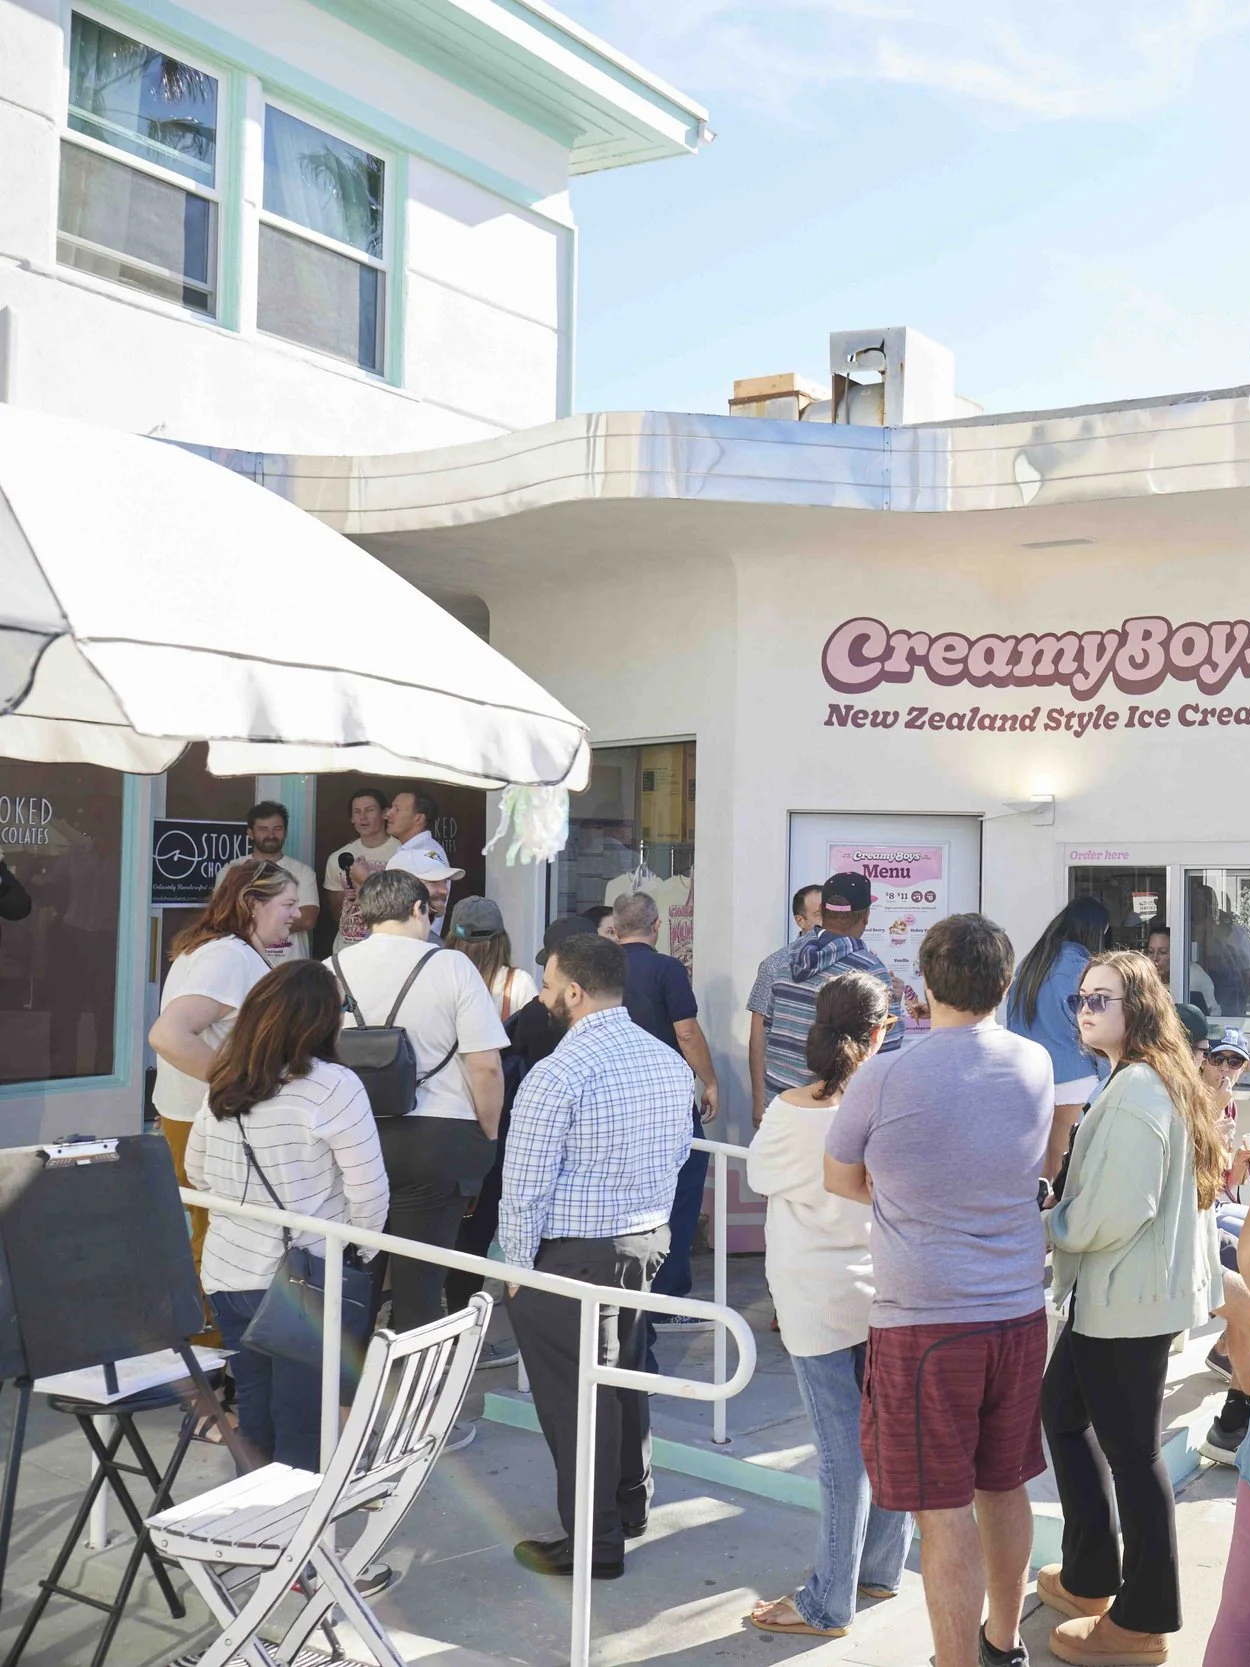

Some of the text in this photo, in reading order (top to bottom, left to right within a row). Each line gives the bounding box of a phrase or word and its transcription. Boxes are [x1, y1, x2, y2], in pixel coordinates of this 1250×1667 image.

[824, 703, 900, 729] New
[904, 706, 1042, 733] Zealand
[1043, 704, 1120, 738] Style
[1124, 705, 1171, 728] Ice
[852, 850, 921, 863] CreamyBoys
[1070, 850, 1130, 860] Order here
[862, 864, 911, 879] Menu
